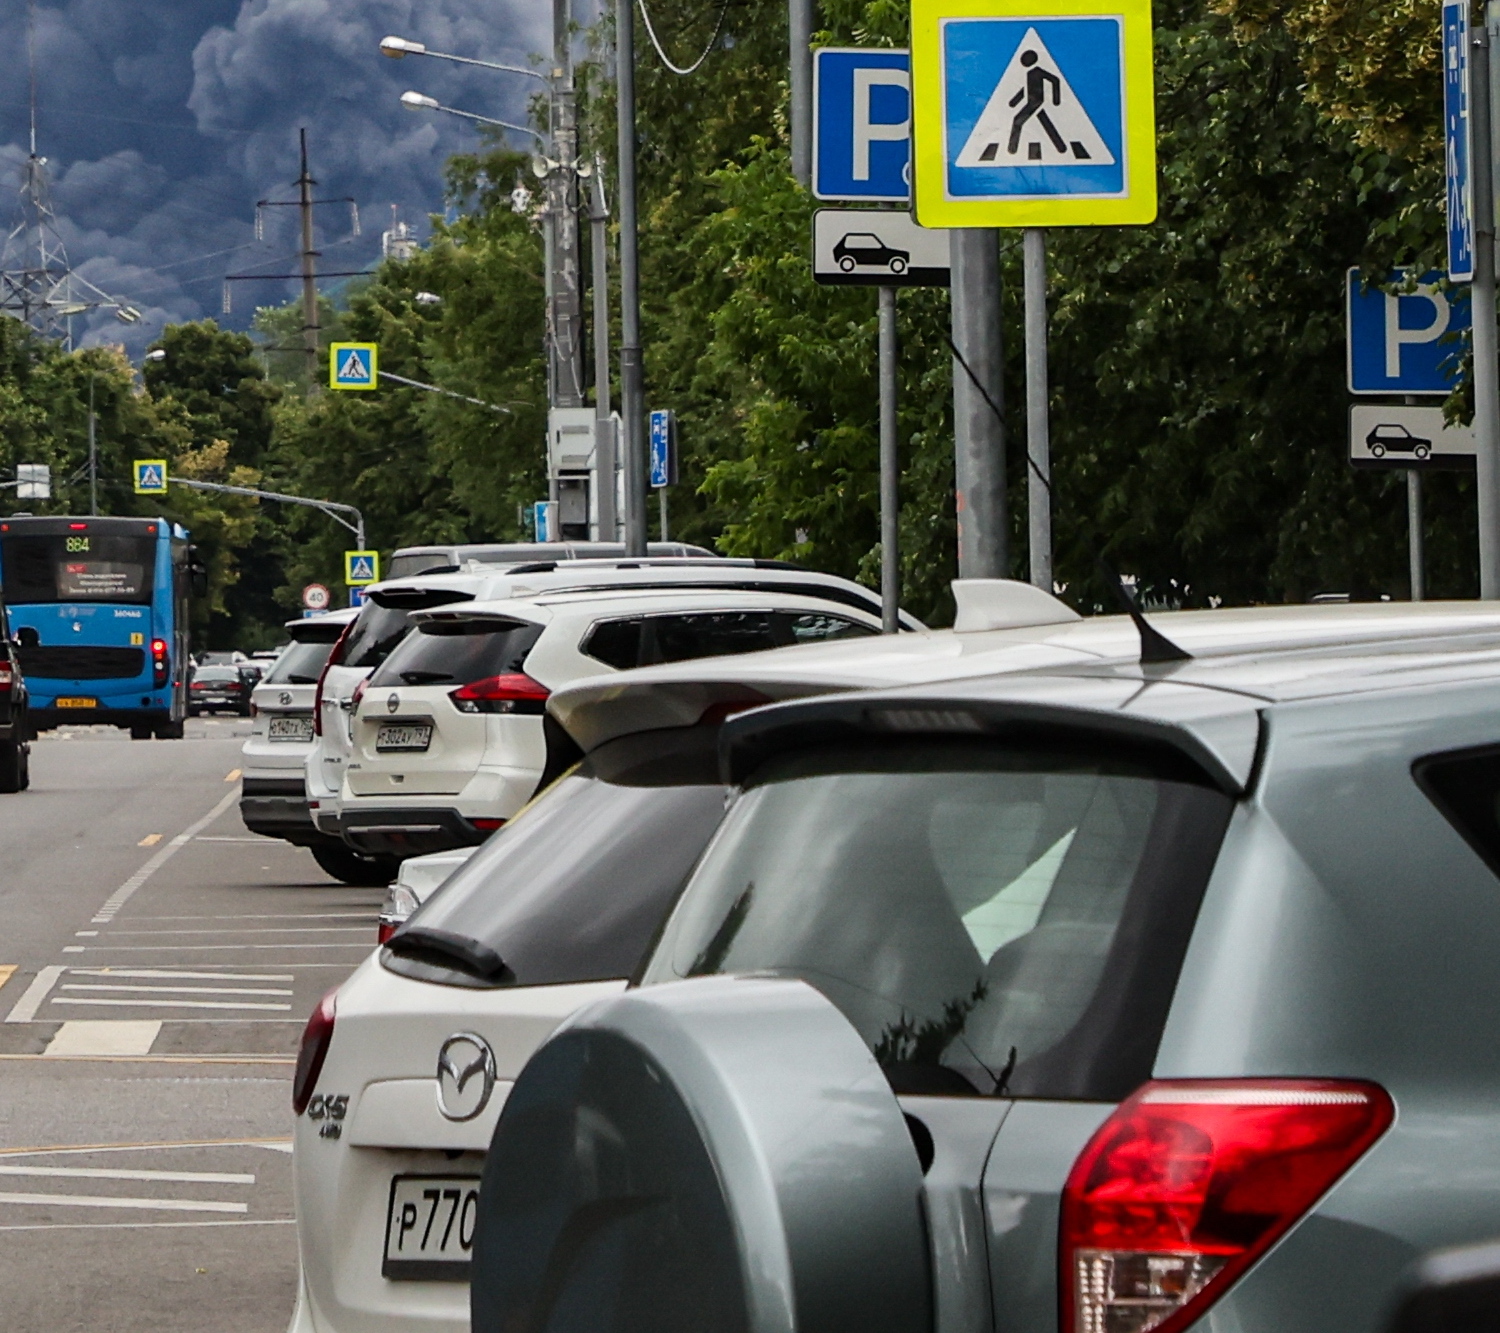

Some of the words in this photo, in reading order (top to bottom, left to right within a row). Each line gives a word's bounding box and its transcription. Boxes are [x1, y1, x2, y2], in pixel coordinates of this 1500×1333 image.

[853, 68, 910, 180] P
[1386, 283, 1450, 377] P
[310, 593, 324, 603] 40
